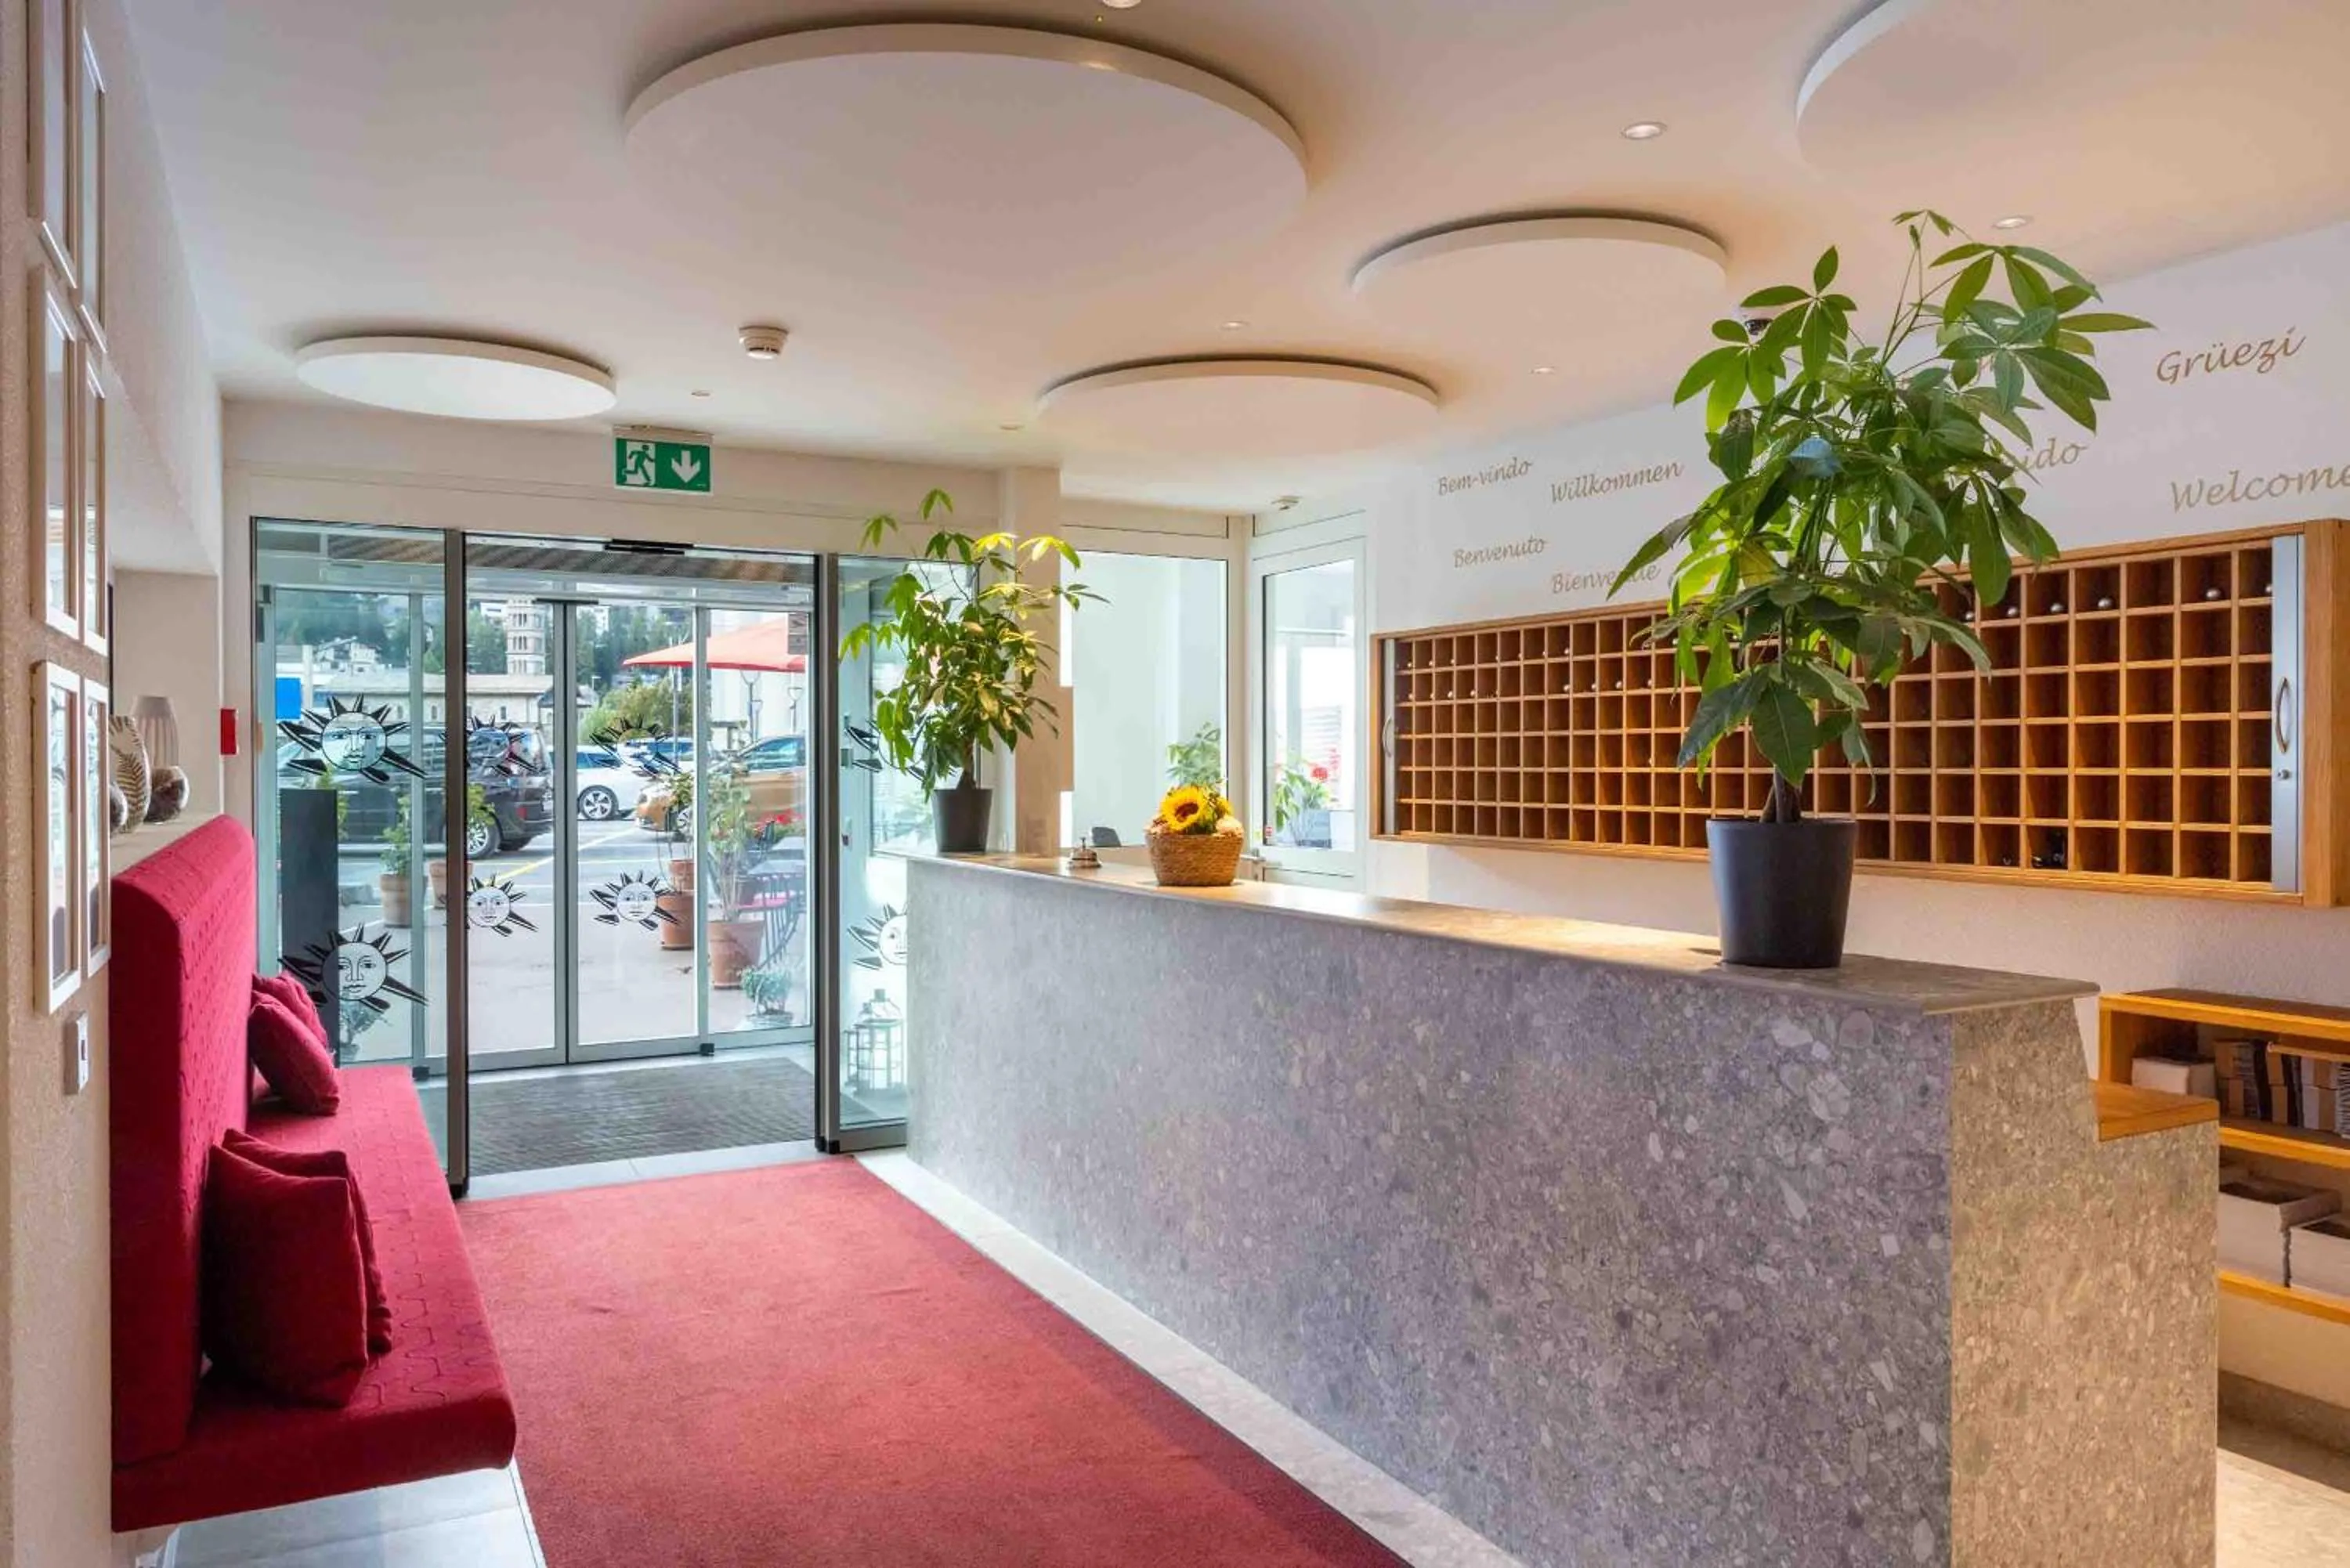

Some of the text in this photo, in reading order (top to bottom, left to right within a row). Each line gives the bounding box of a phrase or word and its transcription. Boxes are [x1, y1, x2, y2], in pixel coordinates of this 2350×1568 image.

[2157, 326, 2306, 384] Grüezi
[1438, 457, 1532, 495] Bem-vindo
[1551, 462, 1684, 503] Willkommen
[2171, 465, 2350, 513] Welcome
[1454, 536, 1548, 568] Benvenuto
